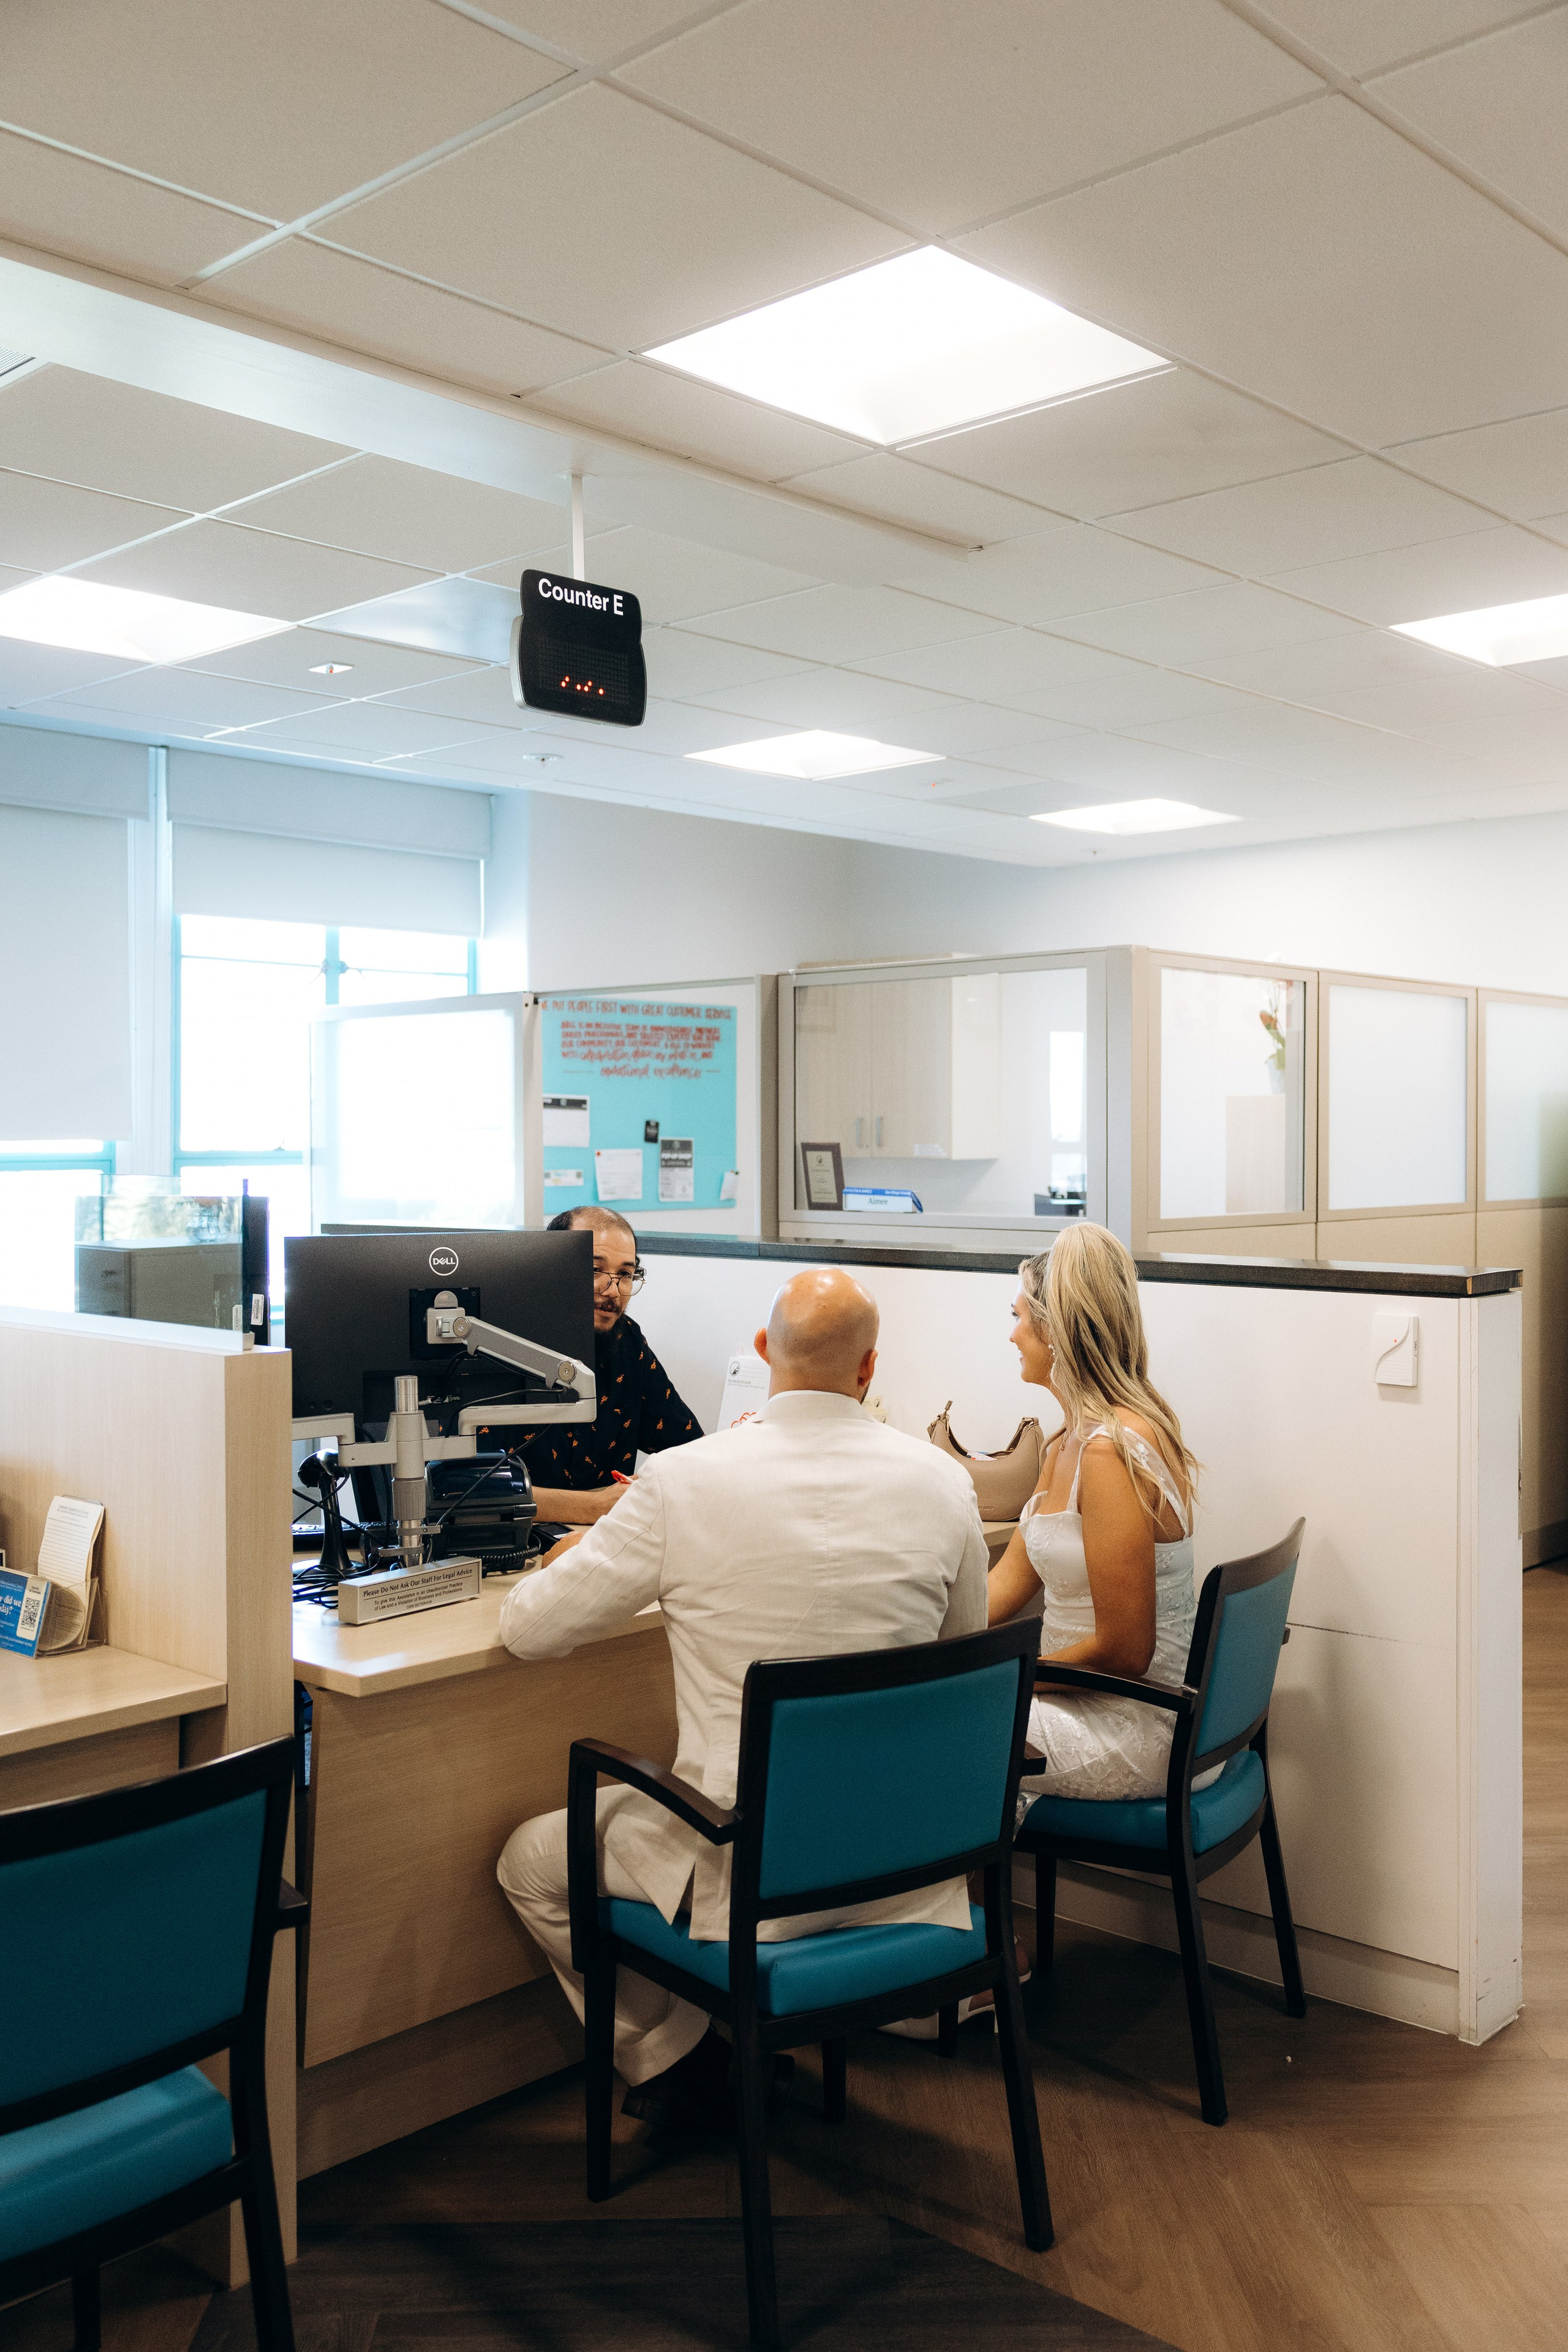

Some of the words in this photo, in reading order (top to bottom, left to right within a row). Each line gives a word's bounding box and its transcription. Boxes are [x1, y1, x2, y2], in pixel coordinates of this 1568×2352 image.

[538, 578, 609, 611] Counter
[614, 594, 624, 616] E
[568, 1000, 592, 1012] PEOPLE
[596, 1001, 617, 1013] FIRST
[620, 1004, 639, 1014] WITH
[642, 1005, 663, 1016] GREAT
[666, 1005, 701, 1018] CUSTOMER
[705, 1008, 731, 1020] SERVICE
[426, 1585, 448, 1593] Unauthorized
[442, 1587, 462, 1596] Professions
[4, 1595, 13, 1605] did
